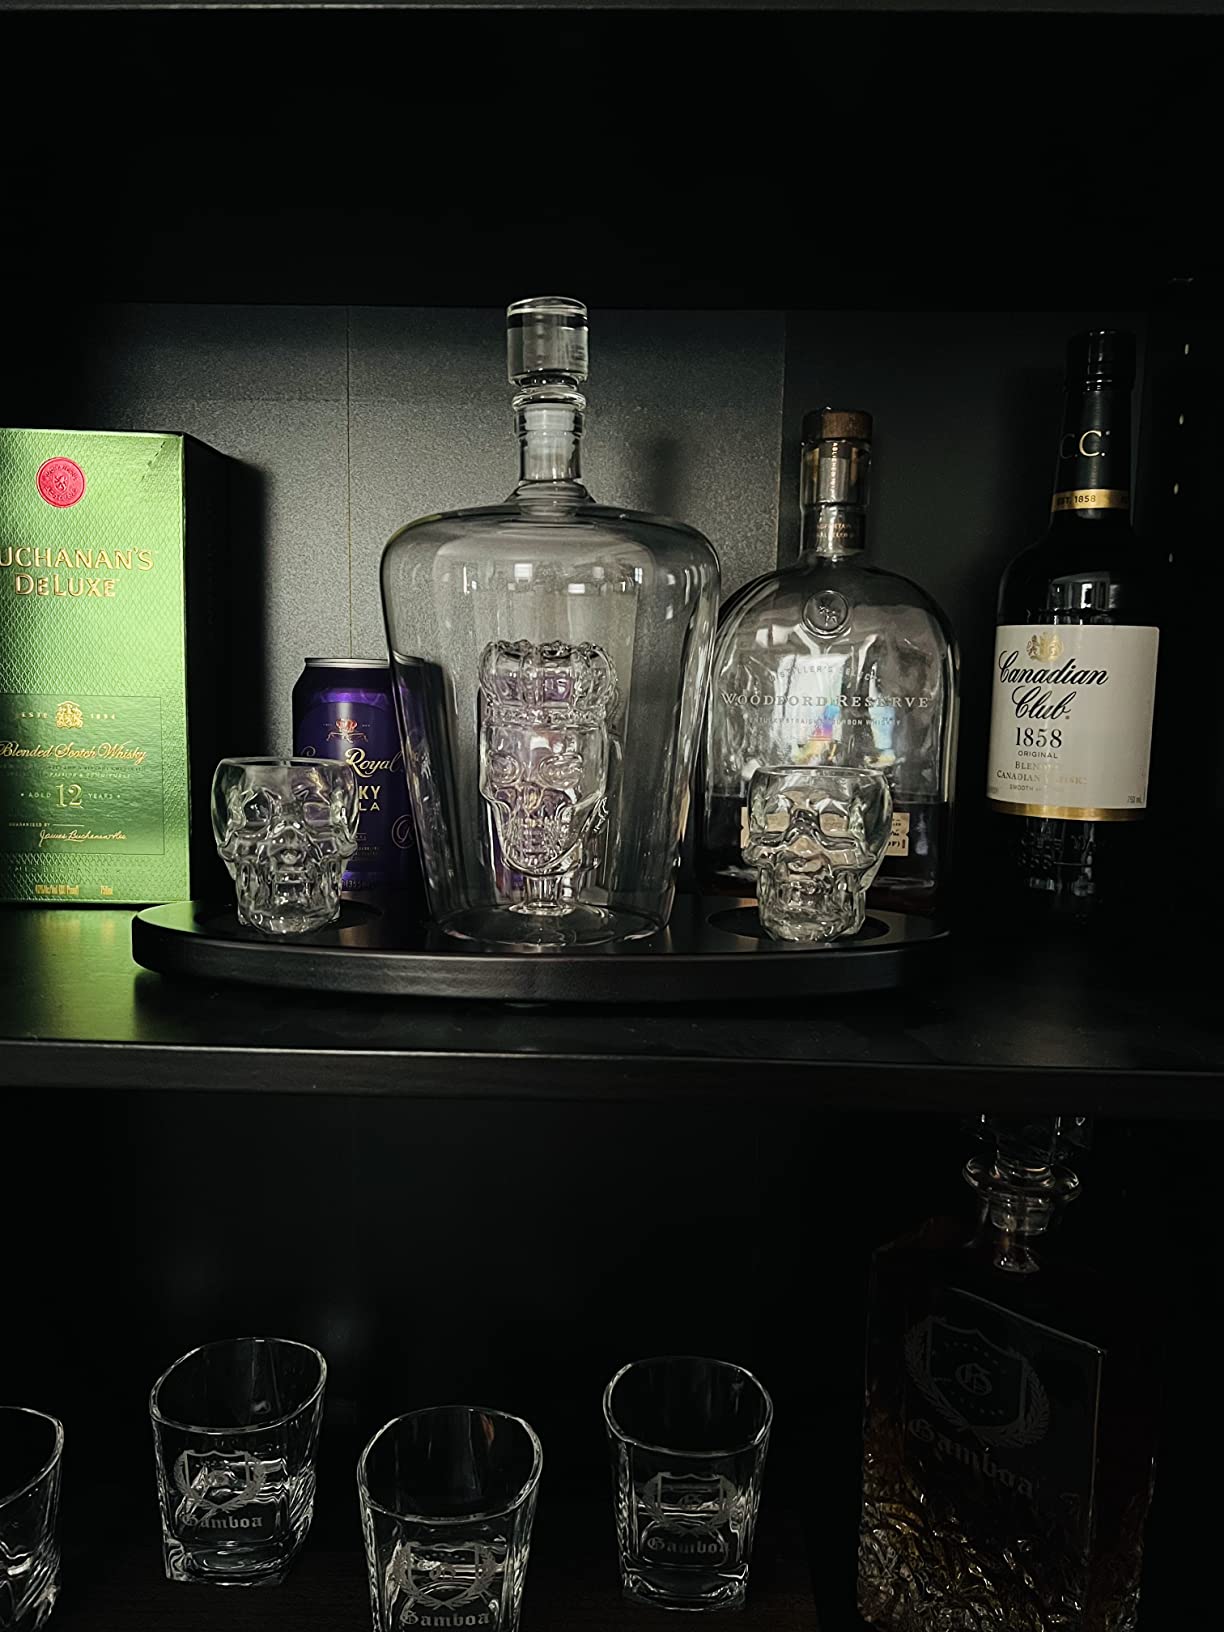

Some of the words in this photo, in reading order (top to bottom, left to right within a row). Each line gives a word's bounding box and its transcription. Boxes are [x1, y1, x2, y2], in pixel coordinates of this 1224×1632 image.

[1074, 494, 1096, 504] 1858
[0, 545, 155, 571] UCHANAN'S
[14, 572, 117, 598] DELUXE
[998, 650, 1109, 685] Canadian
[720, 691, 828, 707] WOODFORD
[837, 693, 929, 709] RESERVE
[1015, 727, 1062, 749] 1858
[0, 739, 54, 758] Blended
[54, 742, 97, 760] Scotch
[97, 740, 147, 765] Whisky
[344, 747, 402, 778] Royal
[1017, 750, 1059, 759] ORIGINAL
[996, 770, 1041, 782] CANADIAN
[55, 783, 84, 809] 12
[909, 1416, 1034, 1500] Gamboa
[182, 1514, 263, 1530] Gamboa
[399, 1609, 491, 1628] Gamboa
